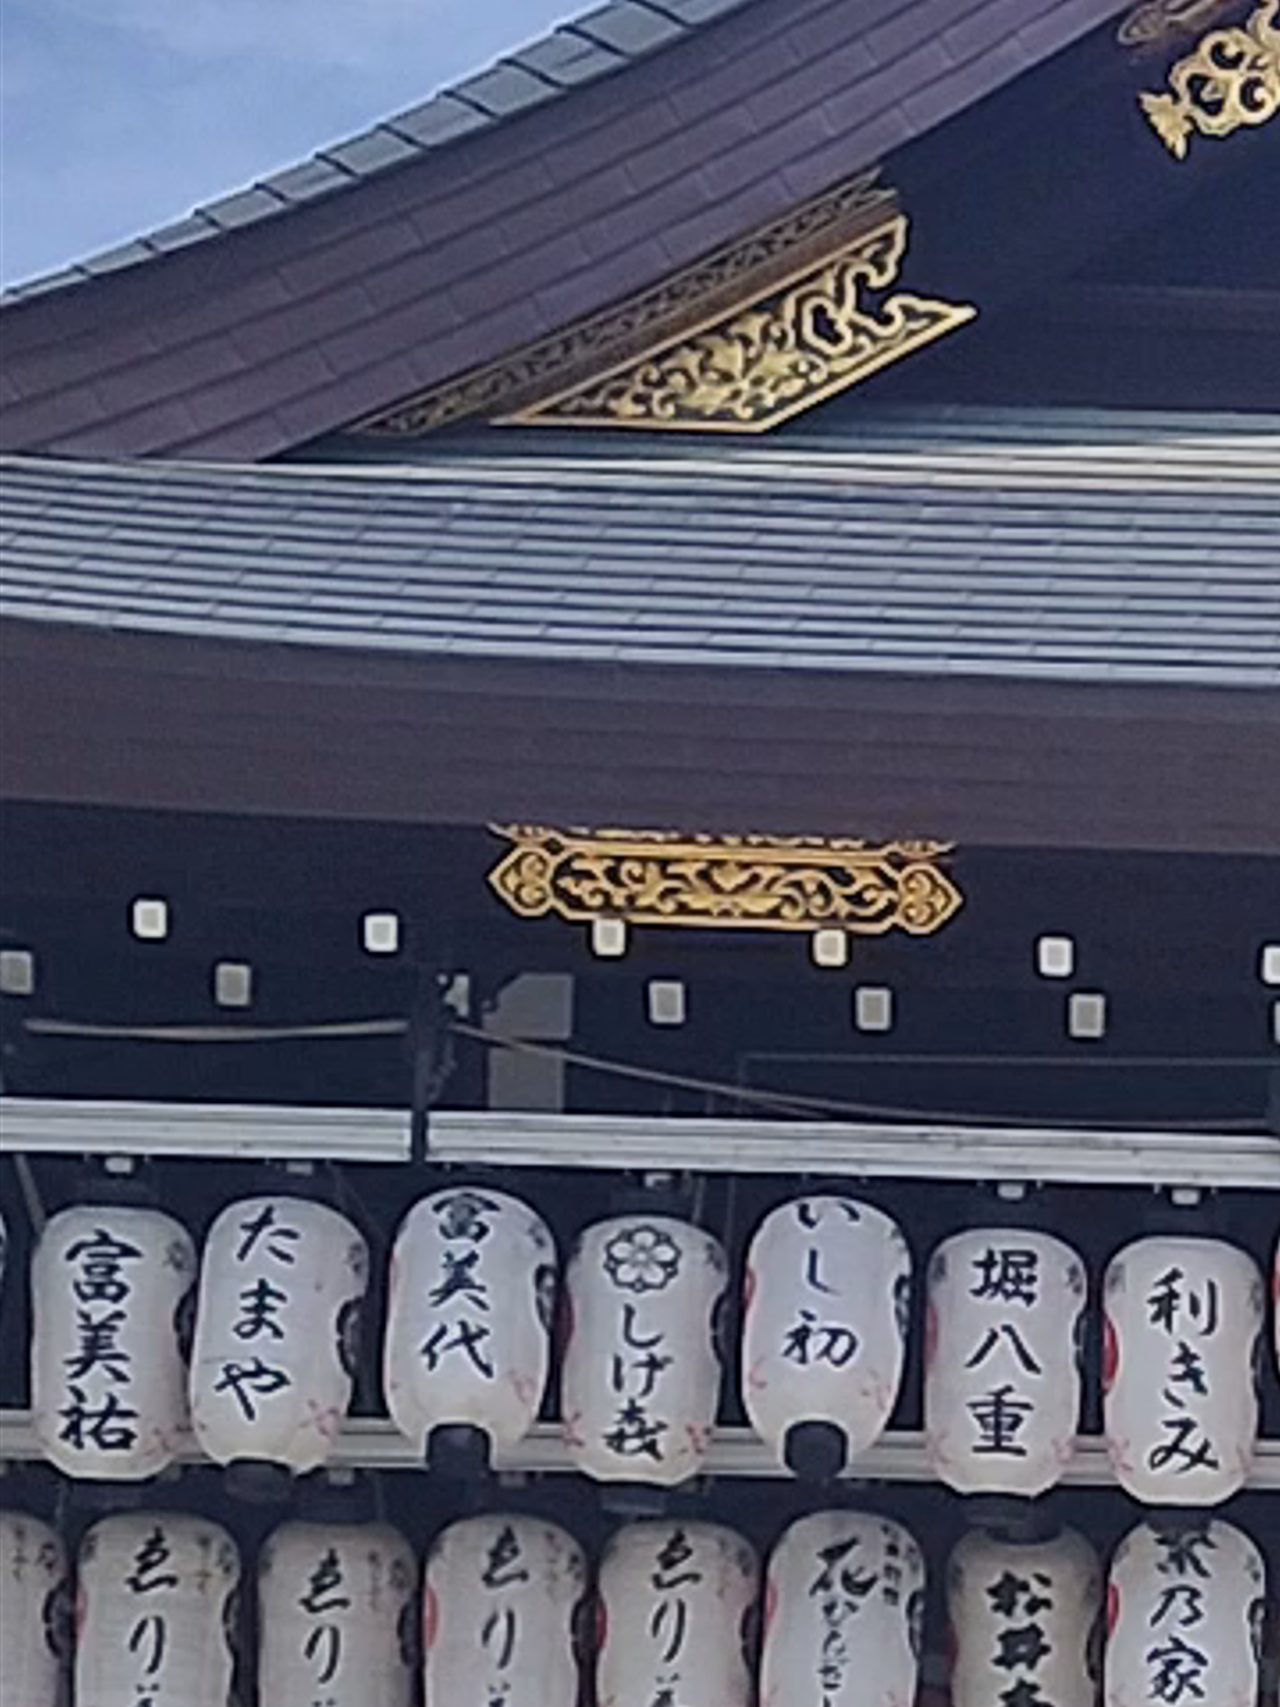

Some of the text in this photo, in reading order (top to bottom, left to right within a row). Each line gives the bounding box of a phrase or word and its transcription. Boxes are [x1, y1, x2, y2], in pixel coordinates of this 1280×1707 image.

[214, 1205, 302, 1421] たまや
[967, 1248, 1043, 1459] 堀八重
[1147, 1268, 1221, 1476] 利きみ
